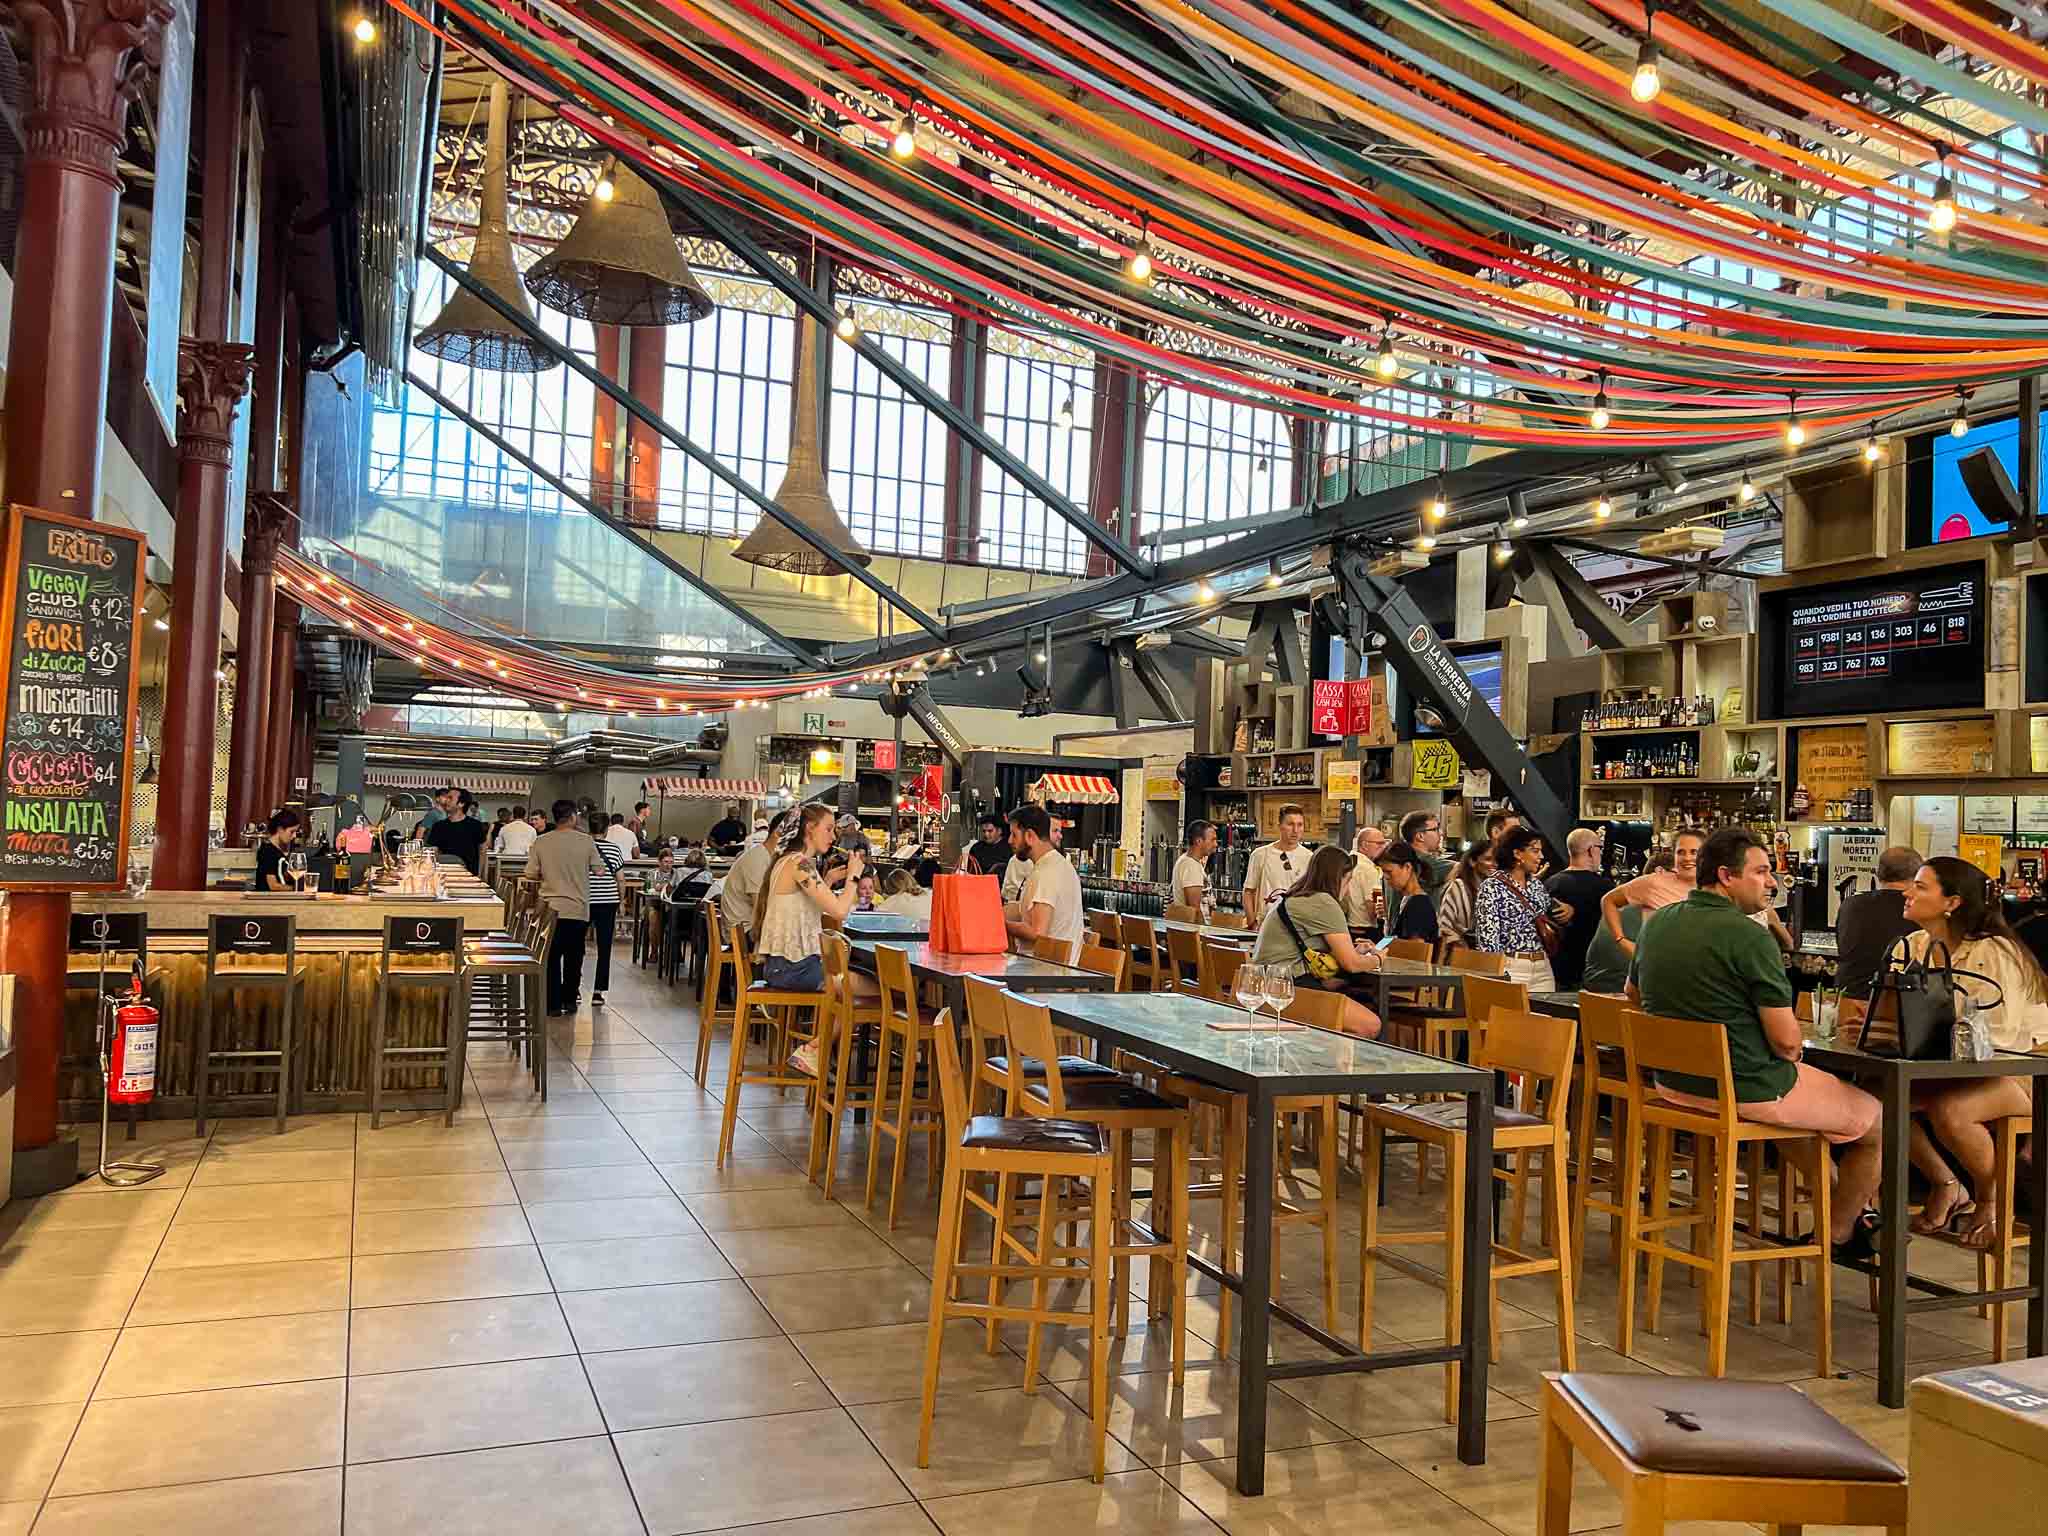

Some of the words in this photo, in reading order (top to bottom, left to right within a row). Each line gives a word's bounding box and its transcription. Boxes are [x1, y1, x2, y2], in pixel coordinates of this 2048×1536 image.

[27, 592, 77, 608] CLUB
[1793, 606, 1825, 618] QUANDO
[1826, 604, 1844, 613] VEDI
[1845, 602, 1852, 611] IL
[1853, 600, 1869, 610] TUO
[1870, 595, 1906, 608] NUMERO
[26, 603, 82, 619] SANDWICH
[89, 598, 123, 620] €12
[1793, 616, 1817, 626] RITIRA
[1817, 610, 1851, 622] L'ORDINE
[1853, 610, 1861, 618] IN
[1948, 616, 1965, 628] 818
[1870, 628, 1886, 640] 136
[1895, 625, 1912, 637] 303
[1923, 622, 1937, 633] 46
[1799, 638, 1814, 648] 158
[1820, 632, 1840, 643] 9381
[1845, 632, 1862, 643] 343
[87, 641, 118, 669] €8
[1870, 656, 1886, 667] 763
[1799, 663, 1814, 673] 983
[1822, 661, 1837, 671] 323
[1845, 658, 1861, 669] 762
[1429, 645, 1441, 661] LA
[1438, 657, 1472, 701] BIRRERIA
[1423, 653, 1438, 671] Ditta
[1435, 669, 1450, 687] Luigi
[1447, 684, 1468, 709] Moretti
[1316, 683, 1345, 698] CASSA
[1352, 684, 1370, 698] CASSA
[1316, 698, 1330, 707] CASH
[48, 717, 84, 740] €14
[926, 712, 960, 750] INFOPOINT
[1416, 754, 1452, 780] 46
[6, 800, 109, 837] INSALATA
[1844, 836, 1853, 844] LA
[1855, 836, 1876, 844] BIRRA
[1843, 846, 1879, 855] MORETTI
